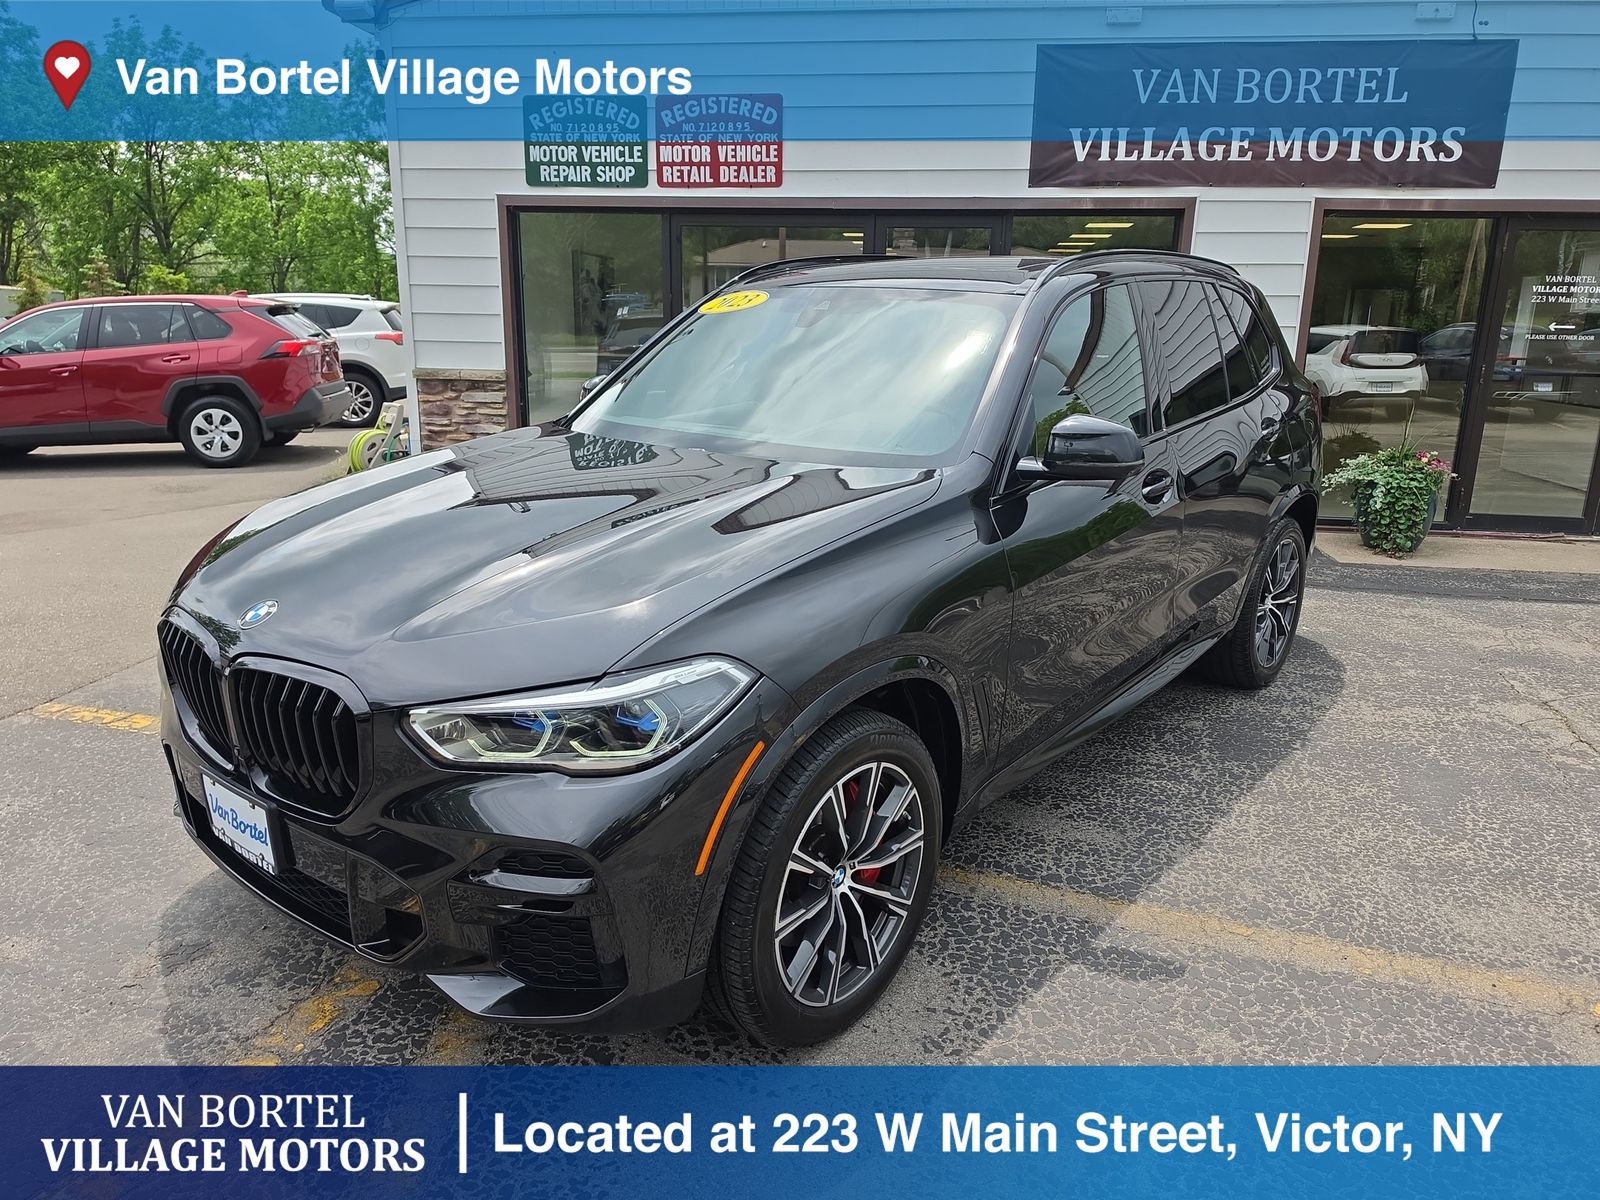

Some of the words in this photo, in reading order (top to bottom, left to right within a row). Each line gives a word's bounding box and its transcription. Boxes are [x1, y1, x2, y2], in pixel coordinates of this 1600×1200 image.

[1132, 68, 1221, 104] VAN
[1234, 66, 1408, 104] BORTEL
[528, 97, 640, 131] REGISTERED
[660, 96, 778, 128] REGISTERED
[566, 123, 620, 132] 7120895
[699, 122, 751, 132] 7120895
[530, 133, 563, 142] STATE
[566, 133, 580, 142] OF
[584, 133, 607, 142] NEW
[611, 133, 641, 143] YORK
[659, 133, 694, 143] STATE
[698, 133, 714, 143] OF
[718, 133, 743, 142] NEW
[747, 133, 779, 143] YORK
[1069, 126, 1257, 163] VILLAGE
[1266, 126, 1466, 163] MOTORS
[529, 145, 576, 163] MOTOR
[581, 145, 643, 163] VEHICLE
[659, 145, 711, 163] MOTOR
[717, 144, 779, 163] VEHICLE
[540, 165, 591, 182] REPAIR
[596, 165, 636, 182] SHOP
[662, 165, 714, 183] RETAIL
[719, 165, 776, 183] DEALER
[1545, 275, 1563, 283] VAN
[1564, 275, 1597, 284] BORTEL
[1532, 285, 1569, 293] VILLAGE
[1569, 286, 1600, 294] MOTOR
[1531, 295, 1546, 303] 223
[1548, 295, 1557, 303] W
[1558, 295, 1578, 303] Main
[1579, 296, 1600, 304] Stree
